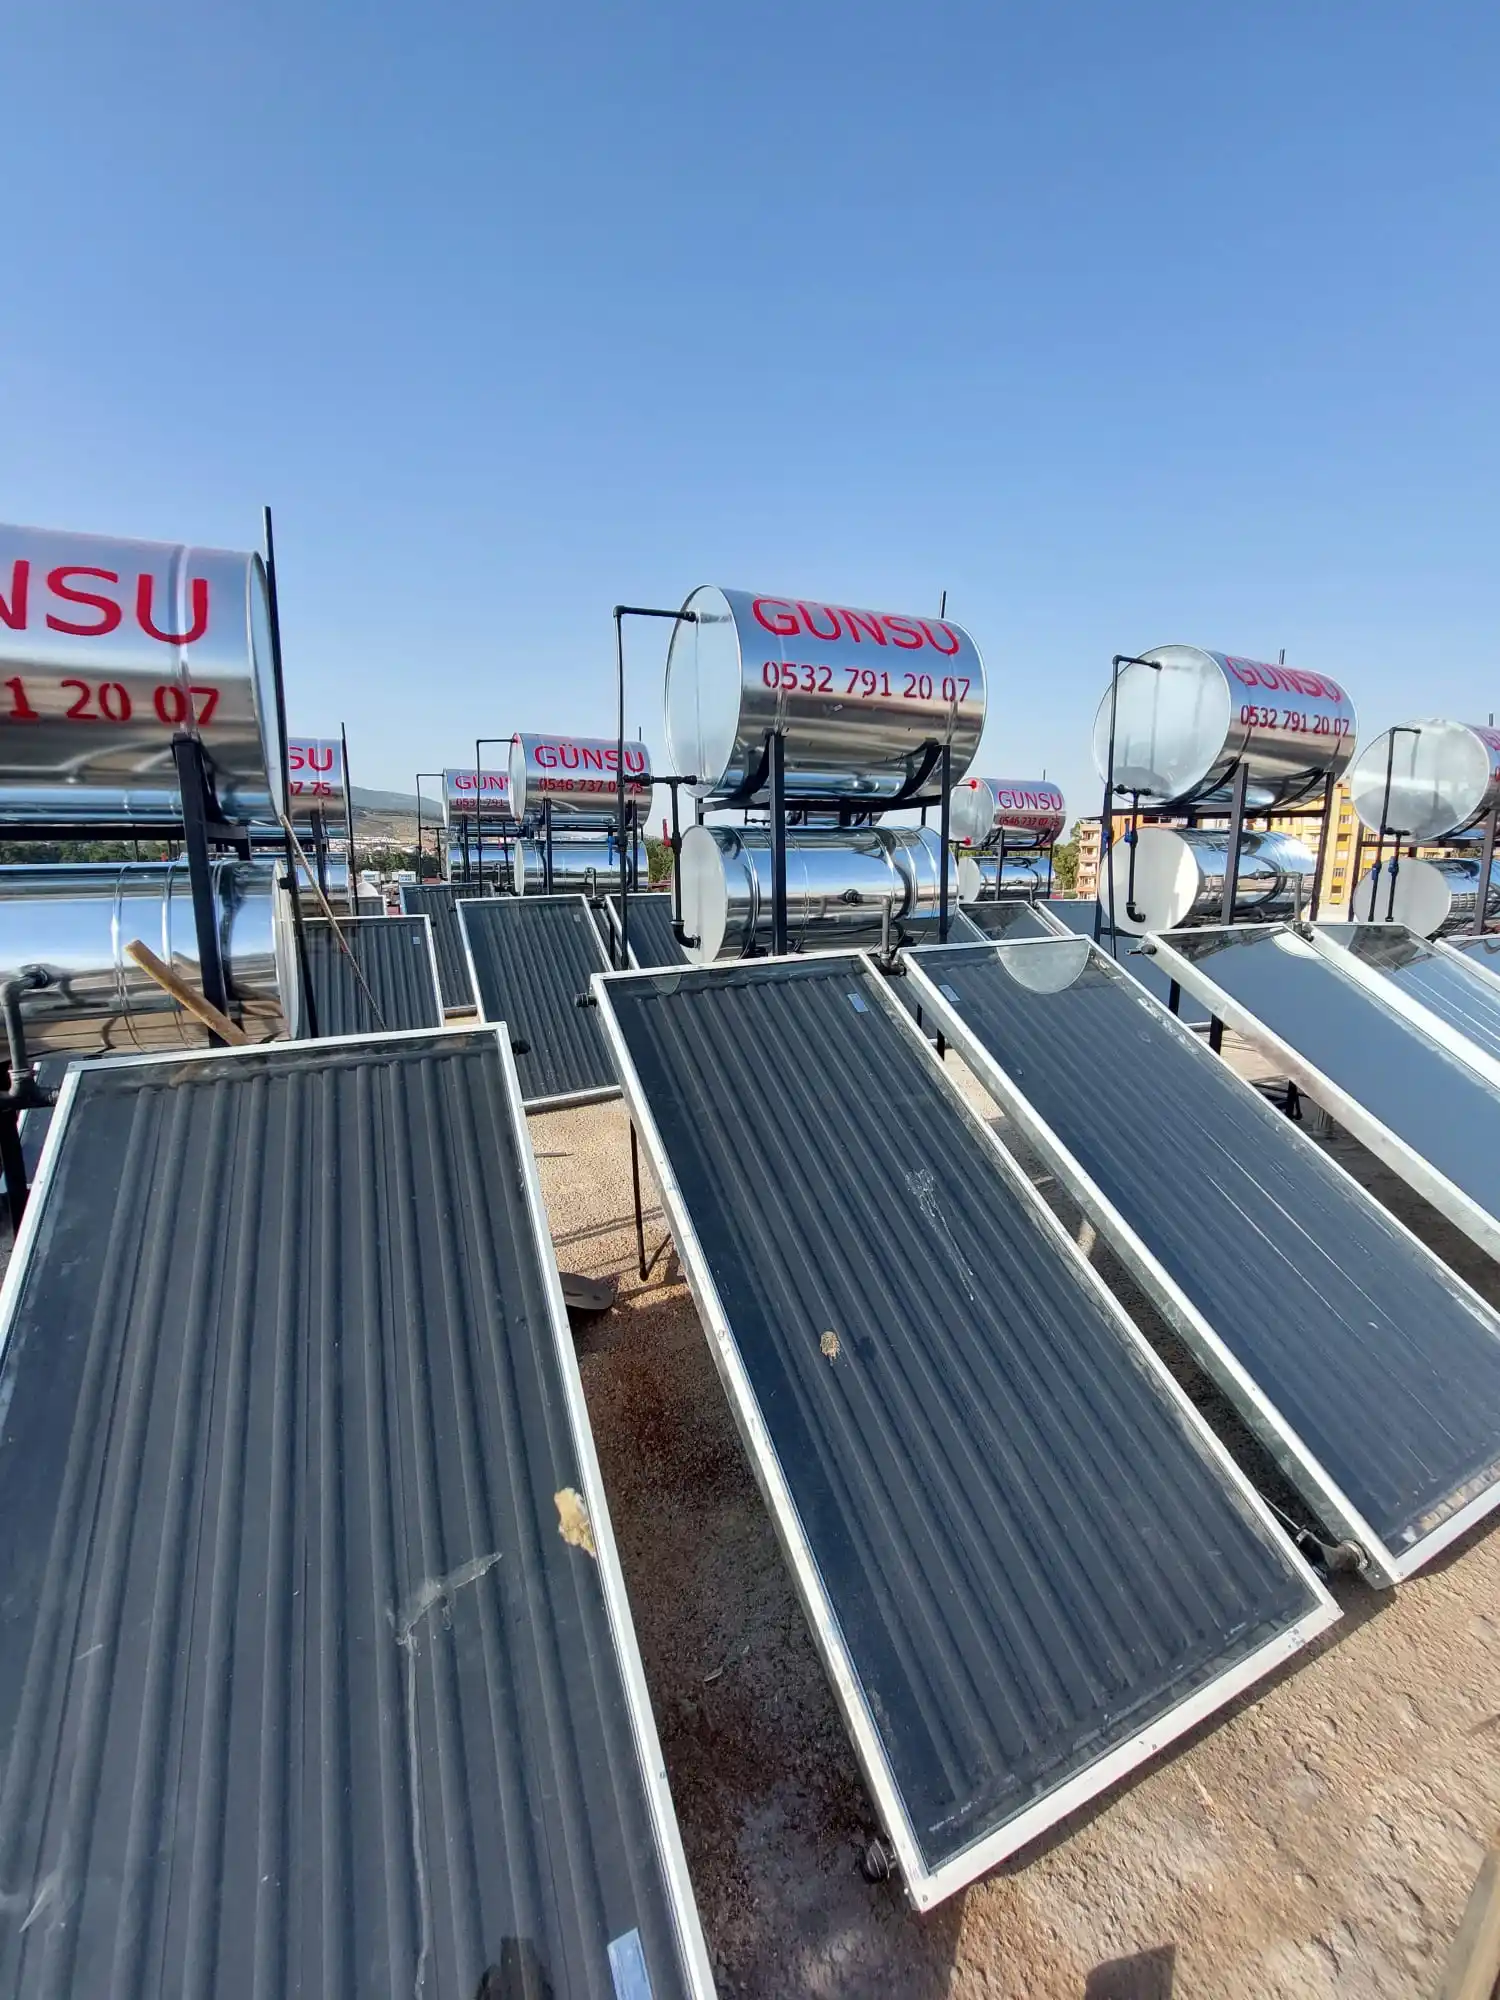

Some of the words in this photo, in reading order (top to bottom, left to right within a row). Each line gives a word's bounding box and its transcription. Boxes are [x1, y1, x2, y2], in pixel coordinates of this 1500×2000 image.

[763, 662, 833, 693] 0532
[845, 669, 892, 698] 791
[904, 674, 932, 700] 20
[943, 677, 970, 702] 07
[61, 680, 131, 722] 20
[154, 685, 220, 725] 07
[1241, 705, 1277, 728] 0532
[1283, 710, 1307, 733] 791
[1313, 715, 1330, 735] 20
[1335, 718, 1350, 737] 07
[310, 782, 331, 796] 75
[540, 778, 574, 791] 0546
[580, 780, 604, 792] 737
[608, 781, 618, 793] 0
[456, 798, 476, 807] 053
